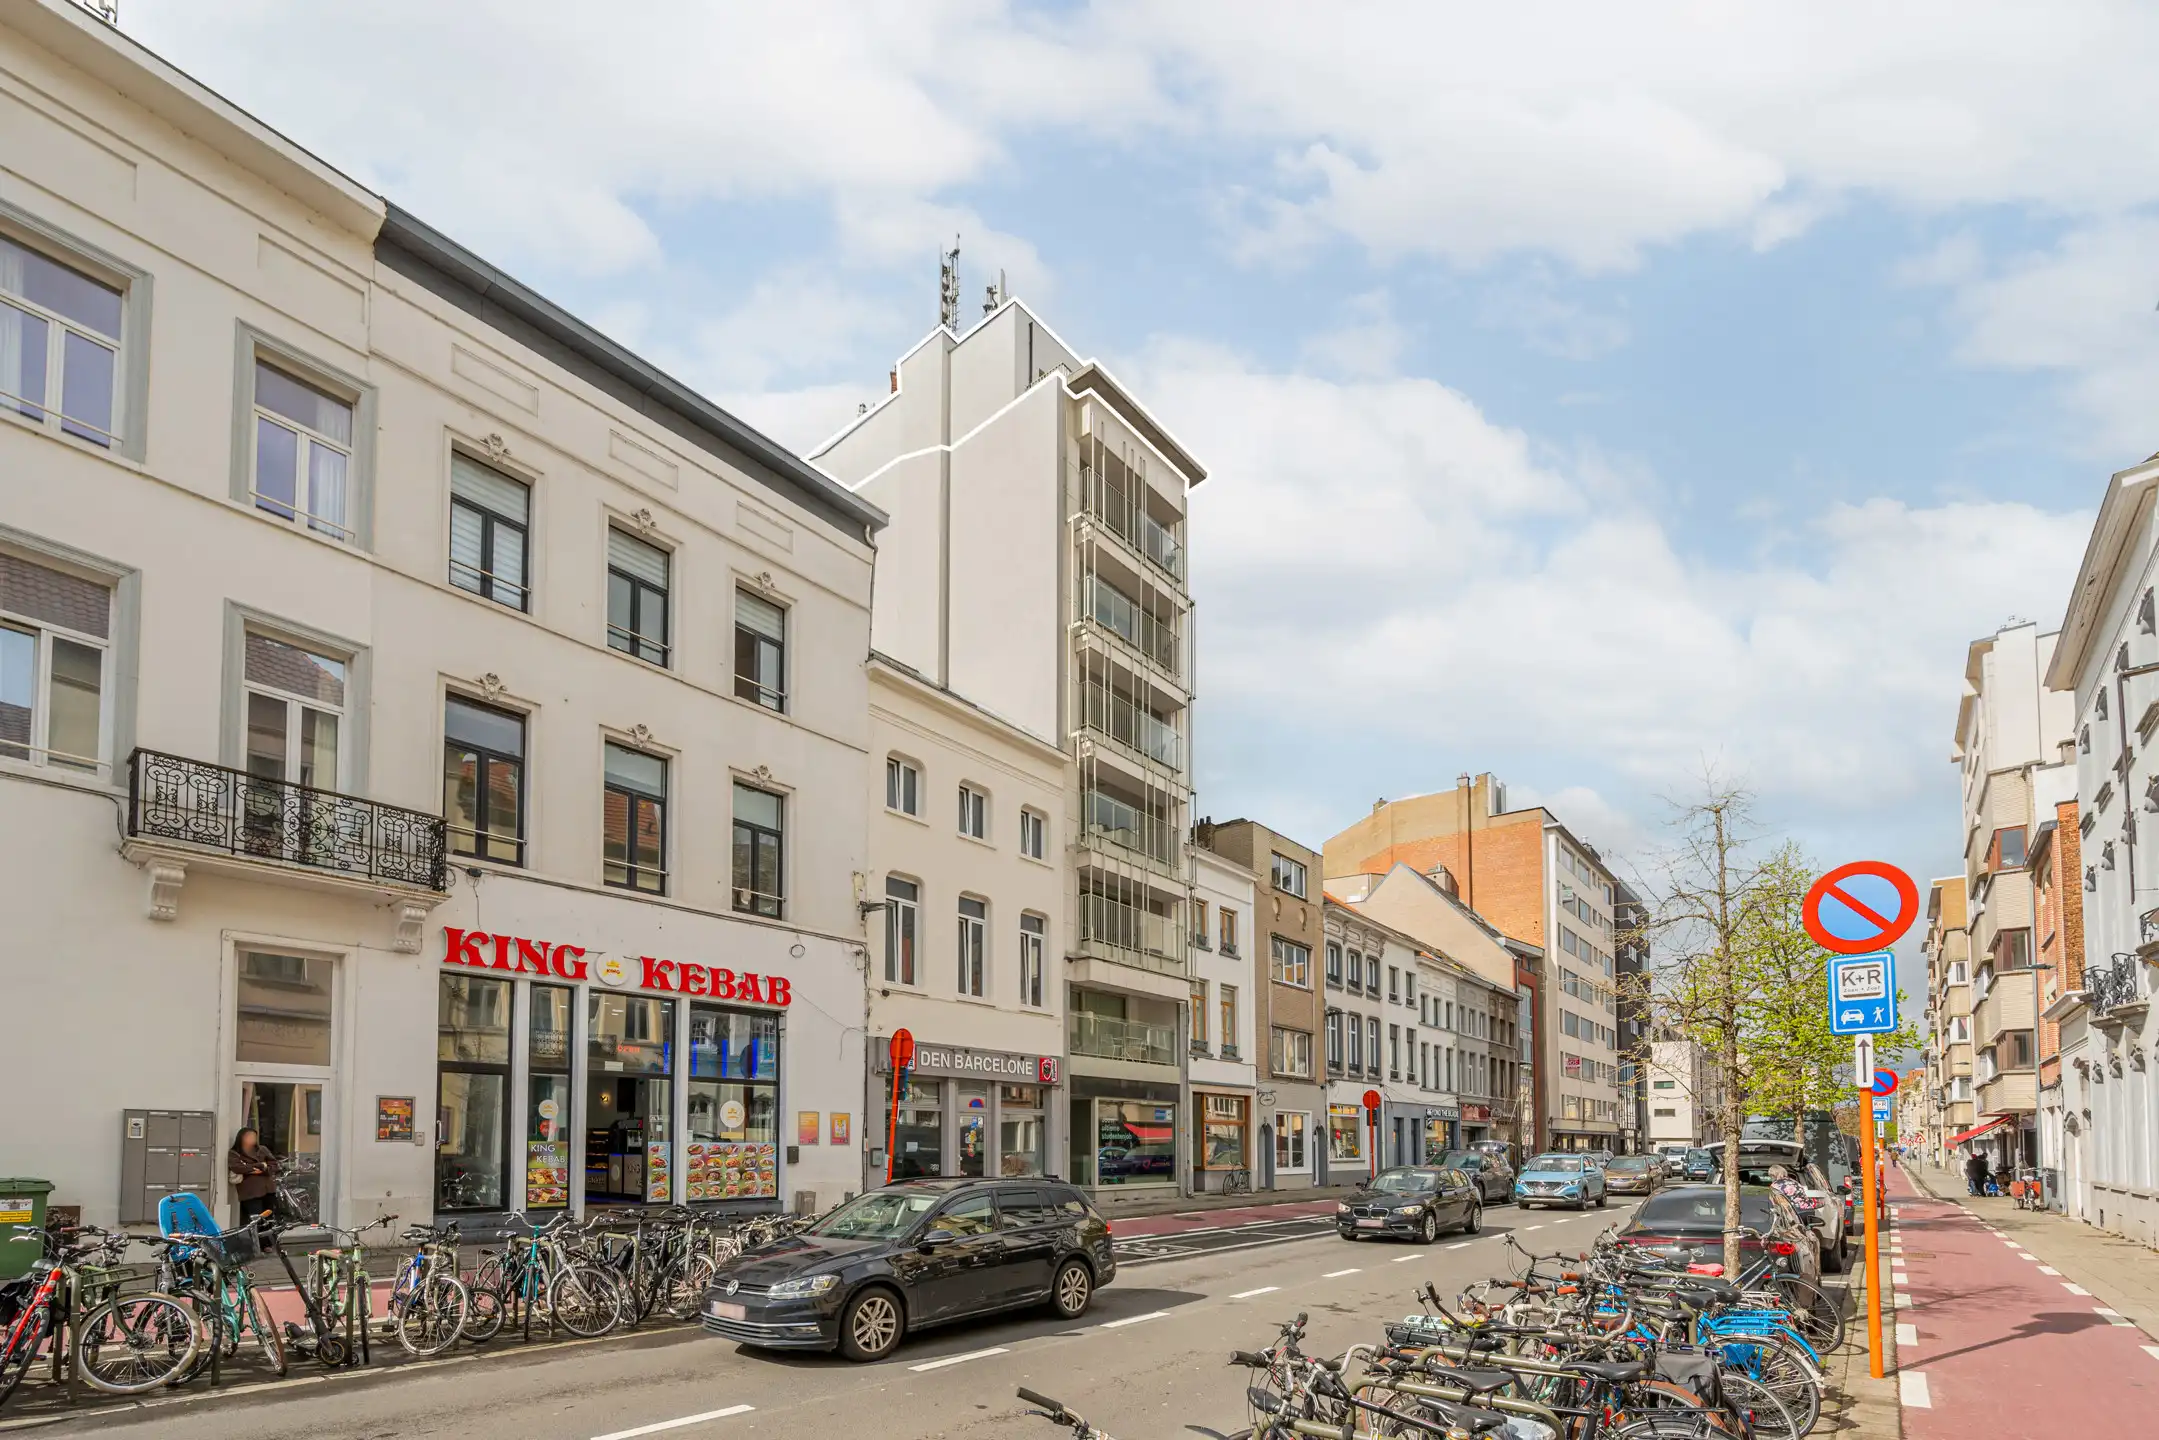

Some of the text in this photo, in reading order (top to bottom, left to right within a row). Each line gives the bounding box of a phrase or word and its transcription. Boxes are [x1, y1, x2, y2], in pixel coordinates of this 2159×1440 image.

[443, 926, 792, 1006] KING KEBAB
[1842, 969, 1881, 987] K+R
[920, 1051, 951, 1068] DEN
[954, 1054, 1033, 1076] BARCELONE
[530, 1144, 556, 1153] KING
[536, 1155, 566, 1163] KEBAB
